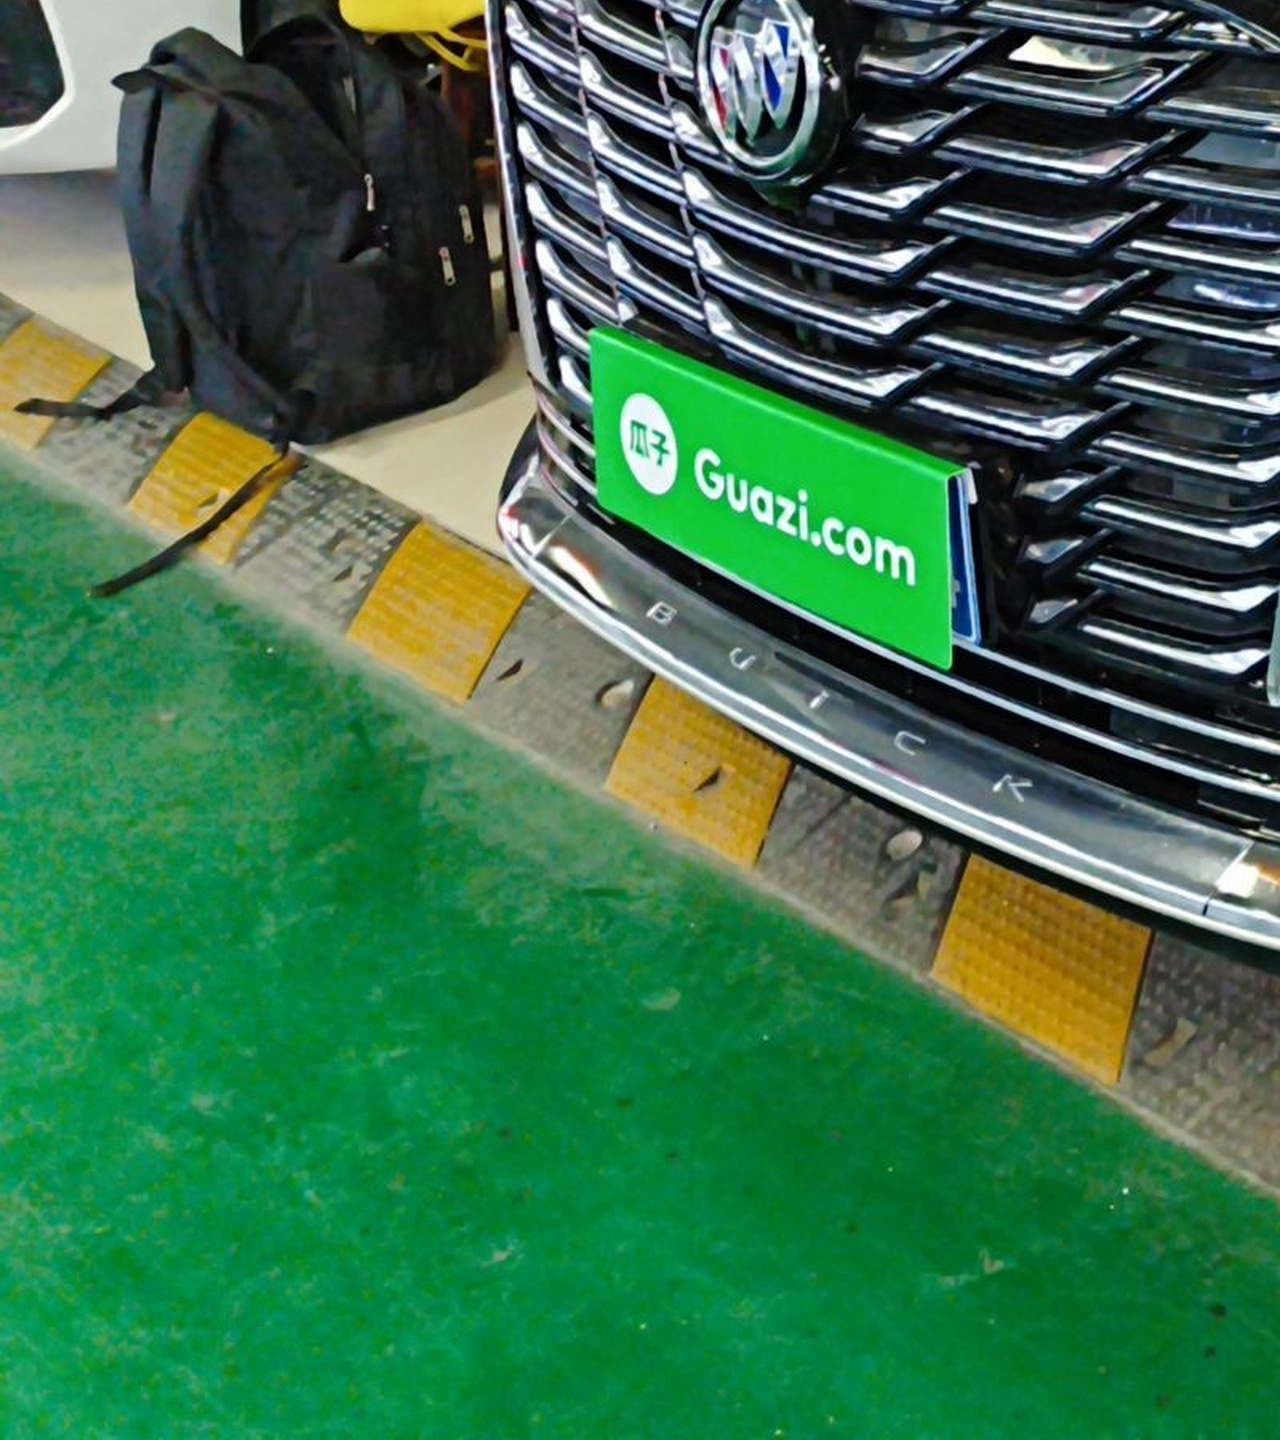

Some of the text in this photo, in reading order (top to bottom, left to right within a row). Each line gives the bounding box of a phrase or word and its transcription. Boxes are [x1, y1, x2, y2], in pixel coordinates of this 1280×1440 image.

[629, 419, 672, 467] 瓜子
[693, 447, 917, 587] Guazi.com
[645, 600, 1033, 802] BUICK
